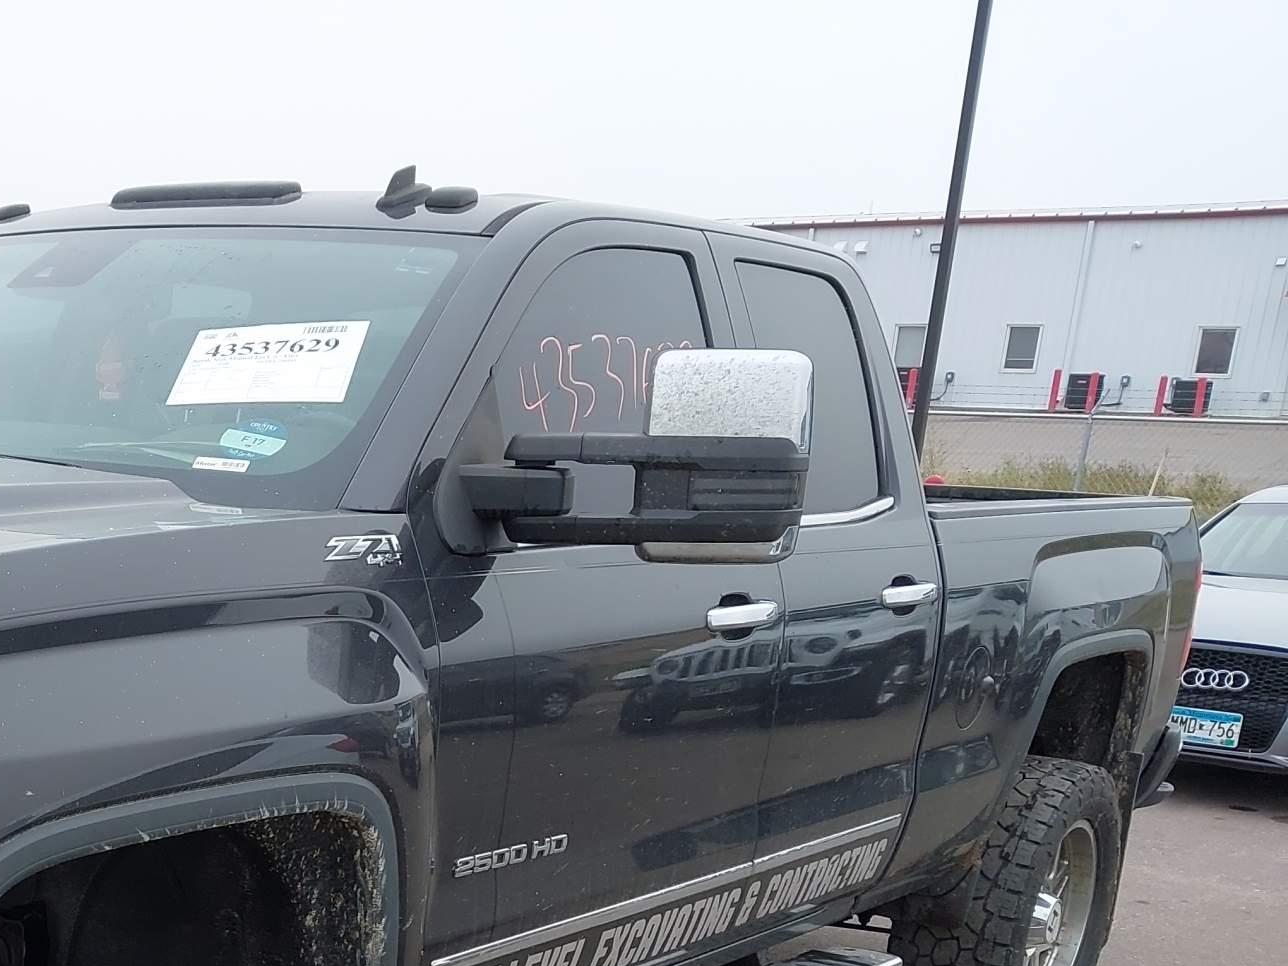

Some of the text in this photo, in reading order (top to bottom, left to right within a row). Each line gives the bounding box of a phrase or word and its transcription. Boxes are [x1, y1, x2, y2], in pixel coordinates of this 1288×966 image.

[205, 337, 340, 357] 43537629
[325, 535, 401, 560] Z71
[1209, 720, 1234, 738] 756
[453, 834, 568, 878] 2500 HD
[734, 880, 761, 927] &
[756, 838, 888, 919] CONTRACTING
